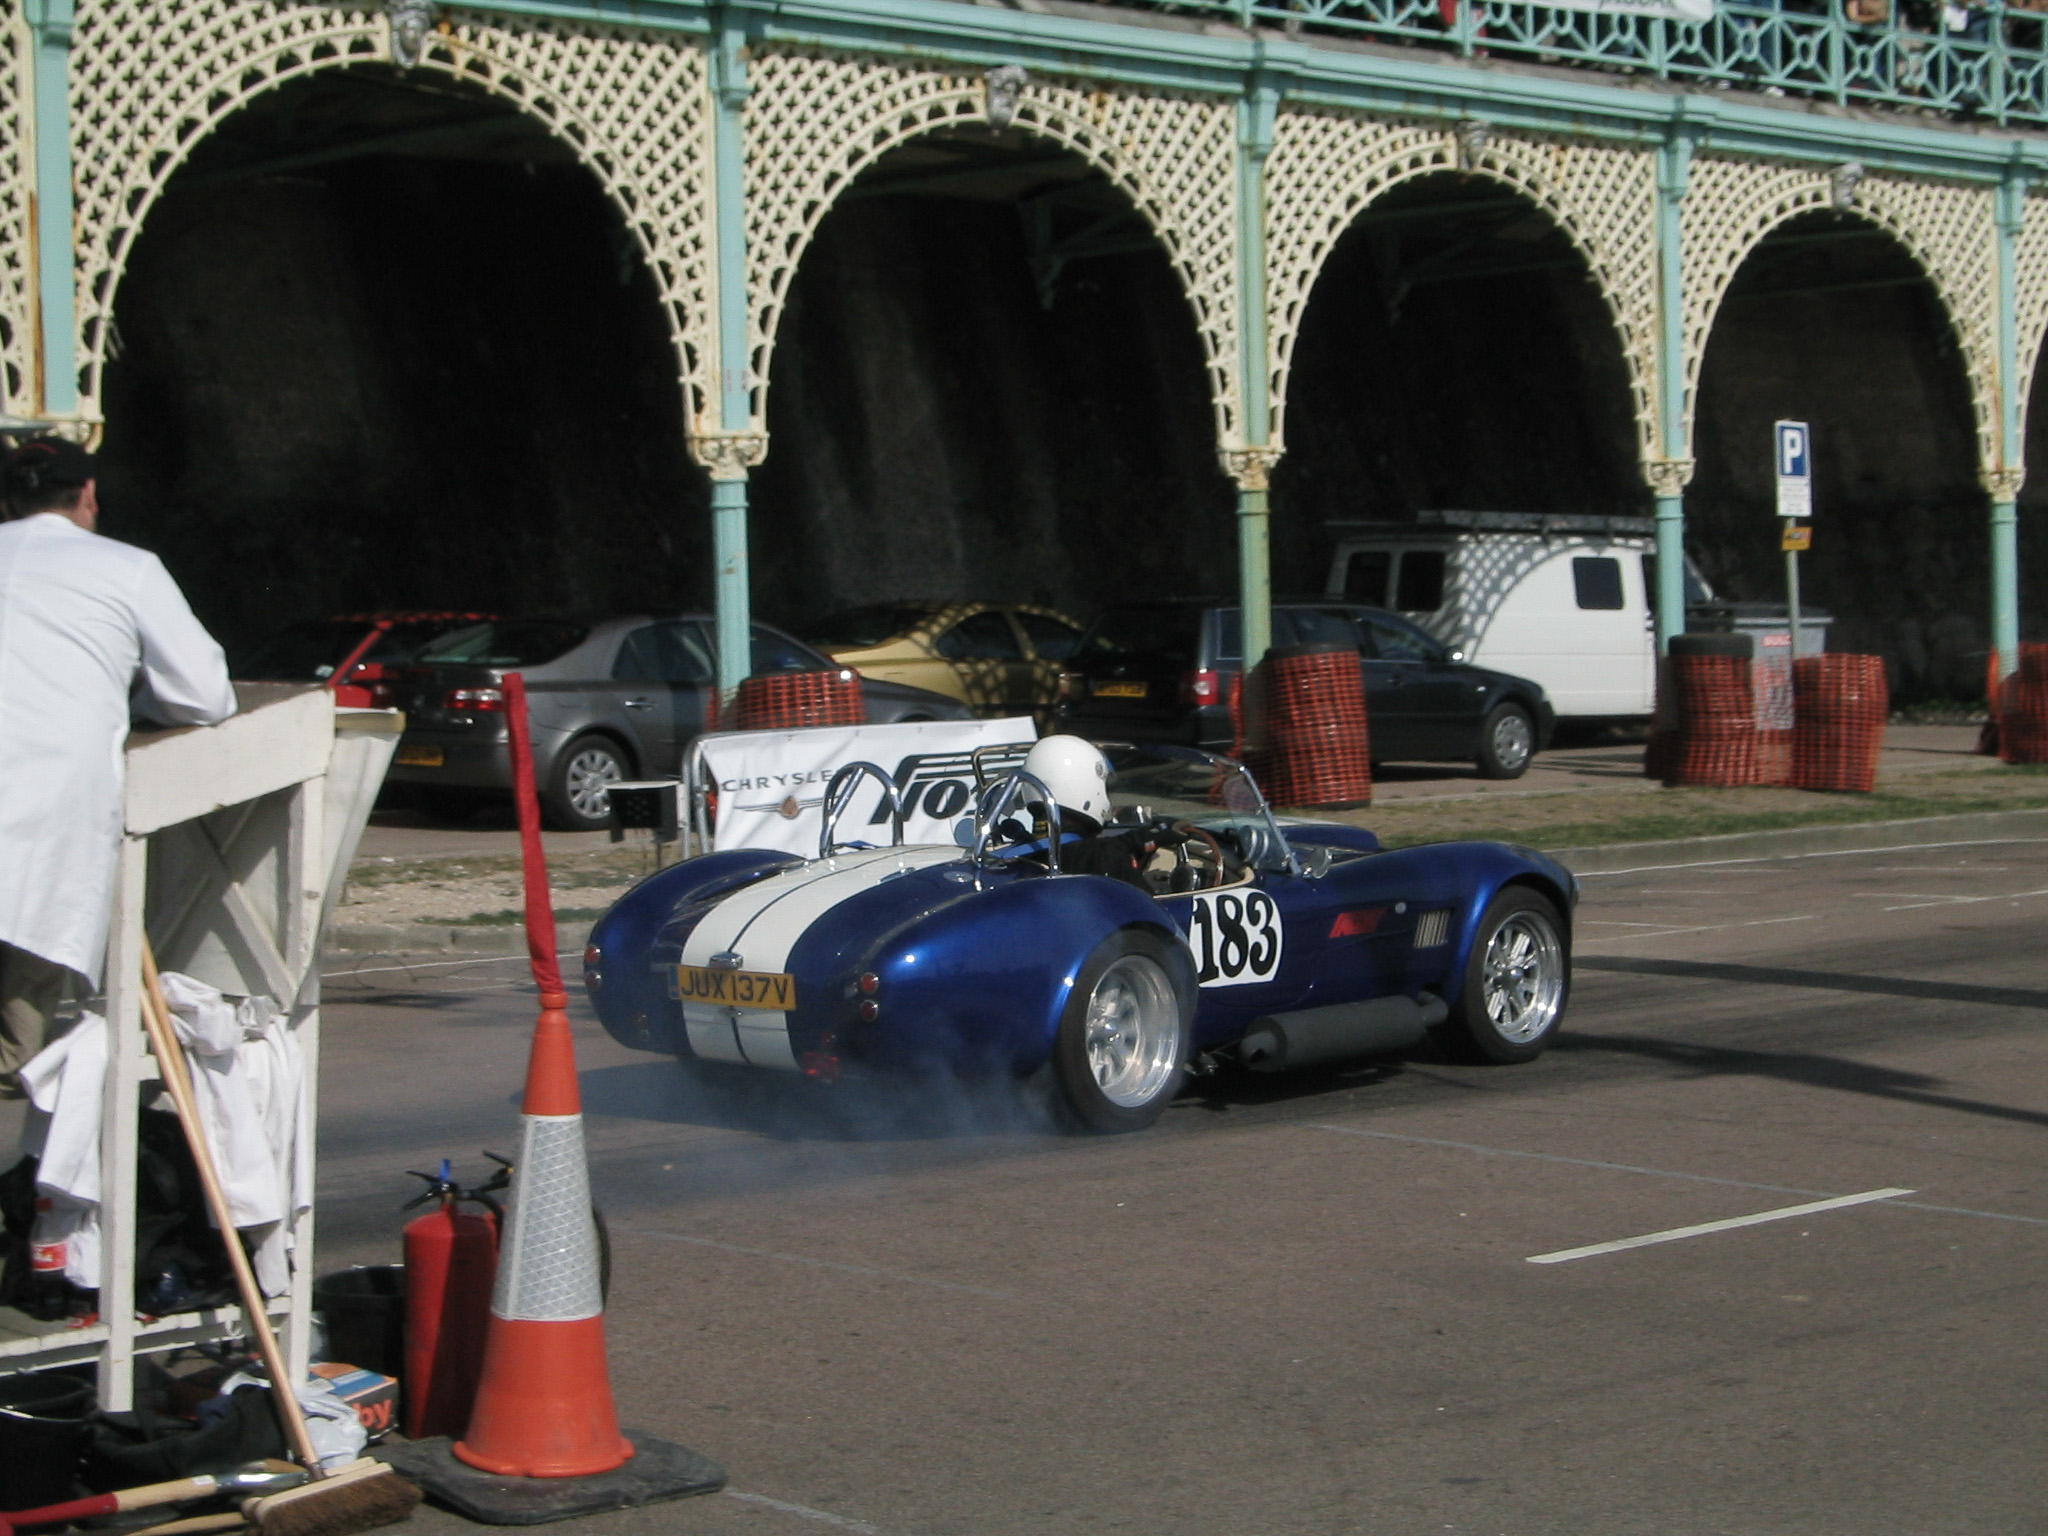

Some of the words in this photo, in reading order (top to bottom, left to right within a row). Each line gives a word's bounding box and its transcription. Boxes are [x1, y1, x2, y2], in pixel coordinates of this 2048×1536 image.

[1783, 429, 1802, 474] P
[721, 769, 834, 791] CHRYSLE
[1193, 891, 1277, 984] 183
